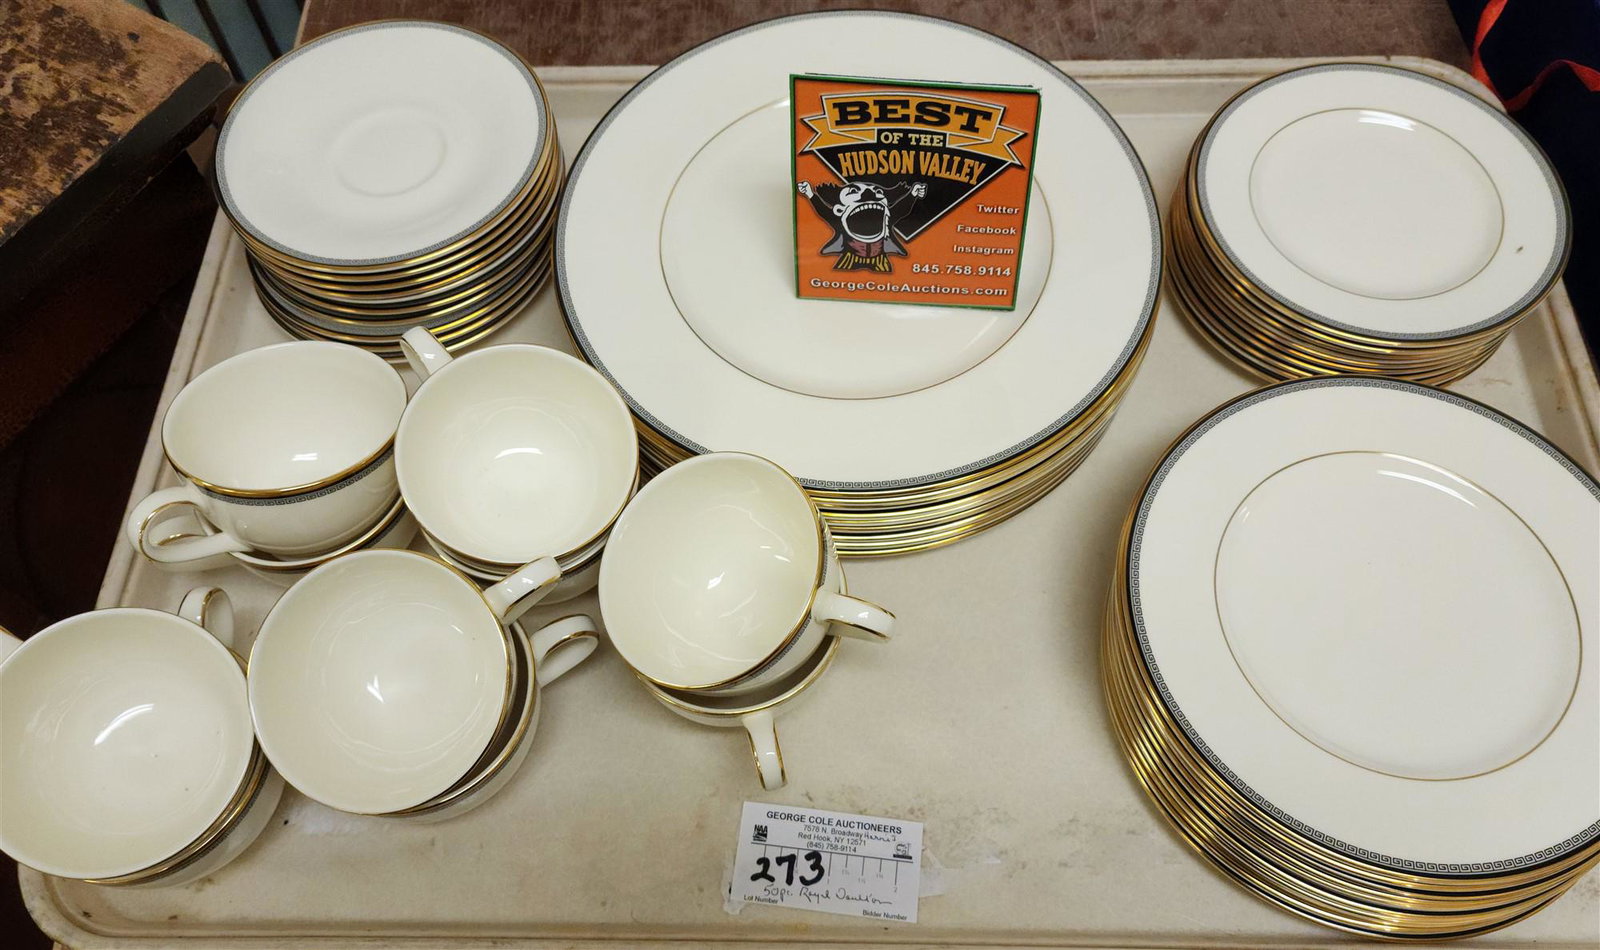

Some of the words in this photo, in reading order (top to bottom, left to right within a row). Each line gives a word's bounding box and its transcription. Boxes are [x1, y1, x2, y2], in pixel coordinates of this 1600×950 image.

[832, 99, 992, 133] BEST
[880, 131, 903, 144] OF
[908, 133, 944, 147] THE
[837, 149, 916, 178] HUDSON
[919, 153, 986, 186] VALLEY
[976, 204, 1020, 215] Twitter
[956, 224, 1017, 235] Facebook
[953, 244, 1015, 256] Instagram
[912, 263, 1012, 277] 845.758.9114
[810, 277, 1009, 296] GeorgeColeAuctions.com
[754, 824, 768, 833] NAA
[766, 811, 807, 823] GEORGE
[808, 816, 834, 826] COLE
[835, 819, 903, 835] AUCTIONEERS
[803, 824, 820, 833] 7578
[831, 828, 863, 839] Broadway
[798, 831, 812, 840] Red
[813, 833, 832, 843] Hook,
[847, 837, 866, 847] 12571
[806, 841, 825, 850] (845)
[826, 843, 857, 853] 758-9114
[750, 850, 825, 886] 273
[754, 895, 778, 904] Number
[862, 909, 882, 918] Bidder
[883, 912, 908, 921] Number
